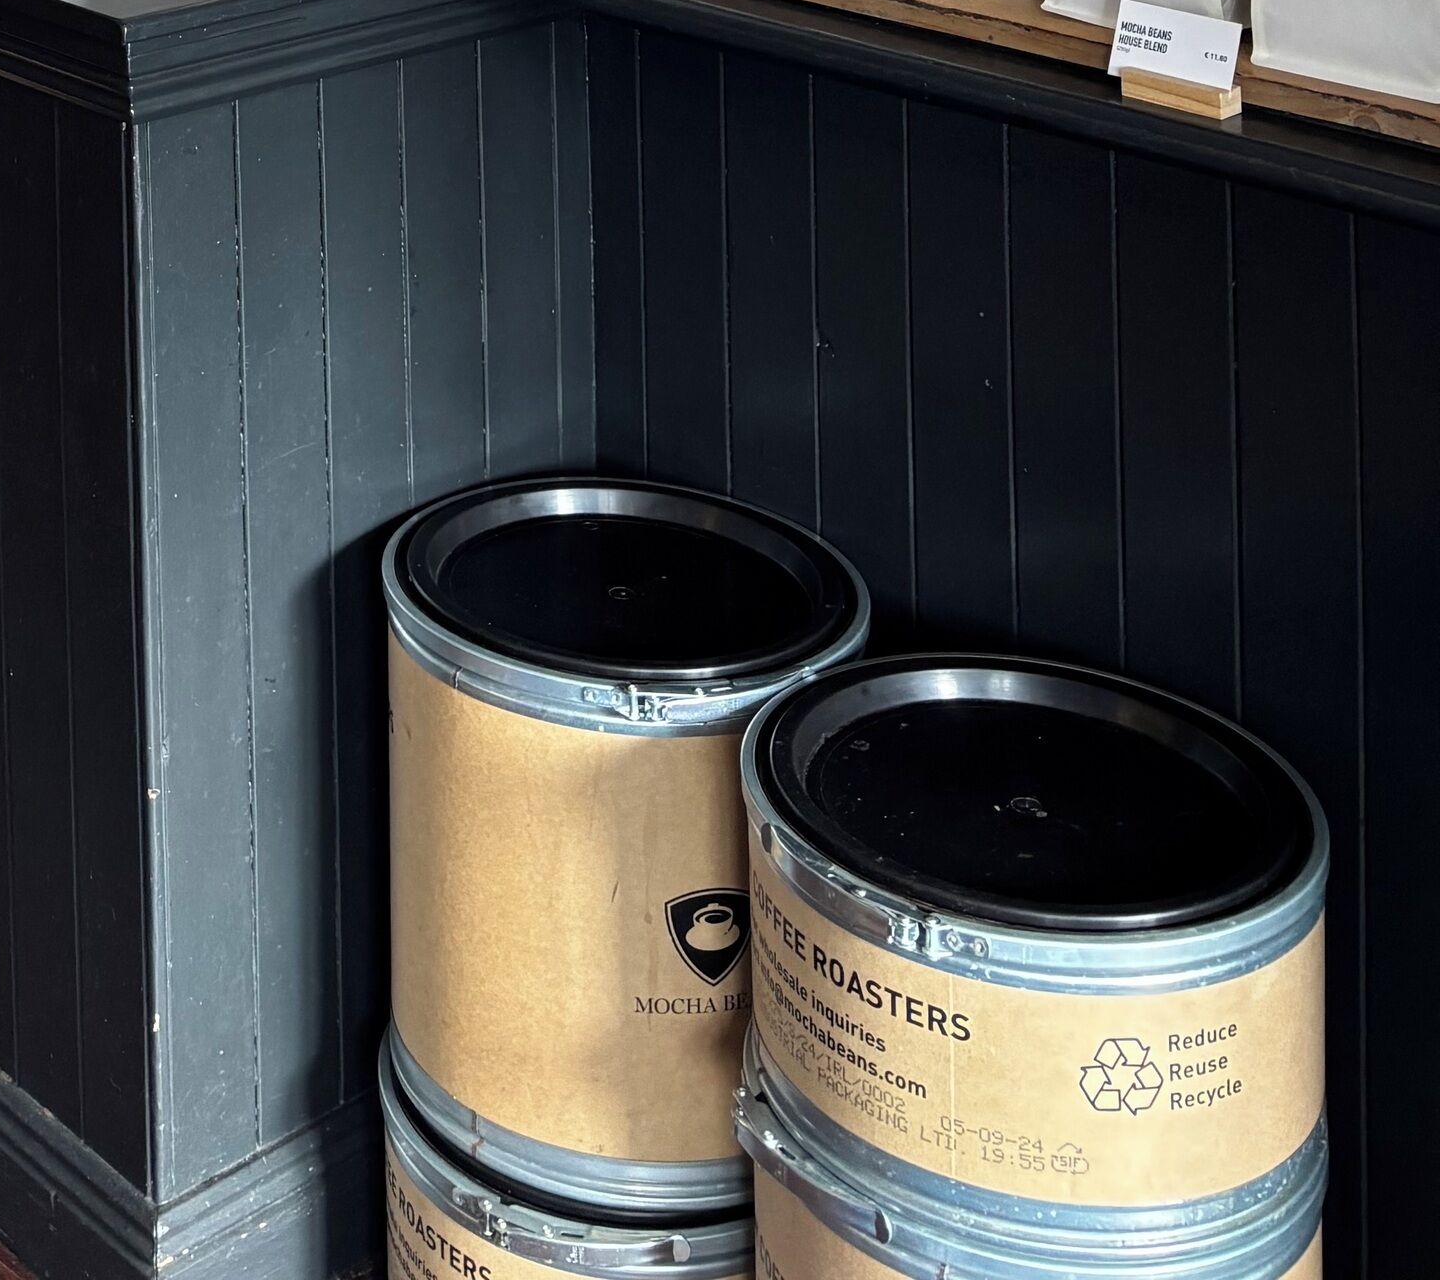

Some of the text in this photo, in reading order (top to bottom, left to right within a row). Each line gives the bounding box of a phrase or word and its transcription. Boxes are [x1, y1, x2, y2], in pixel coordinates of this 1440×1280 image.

[1119, 34, 1168, 54] HOUSE BLEND
[1121, 21, 1172, 41] MOCHA BEANS
[753, 870, 806, 962] COFFEE
[813, 943, 971, 1042] ROASTERS
[634, 997, 717, 1015] MOCHA
[759, 930, 808, 1002] wholesale
[811, 989, 886, 1053] inquiries
[1168, 1023, 1237, 1052] Reduce
[1170, 1055, 1228, 1081] Reuse
[817, 1067, 908, 1134] PACKAGING
[1170, 1078, 1242, 1110] Recycle
[940, 1115, 1043, 1154] 05-09-24
[982, 1146, 1045, 1172] 19:55
